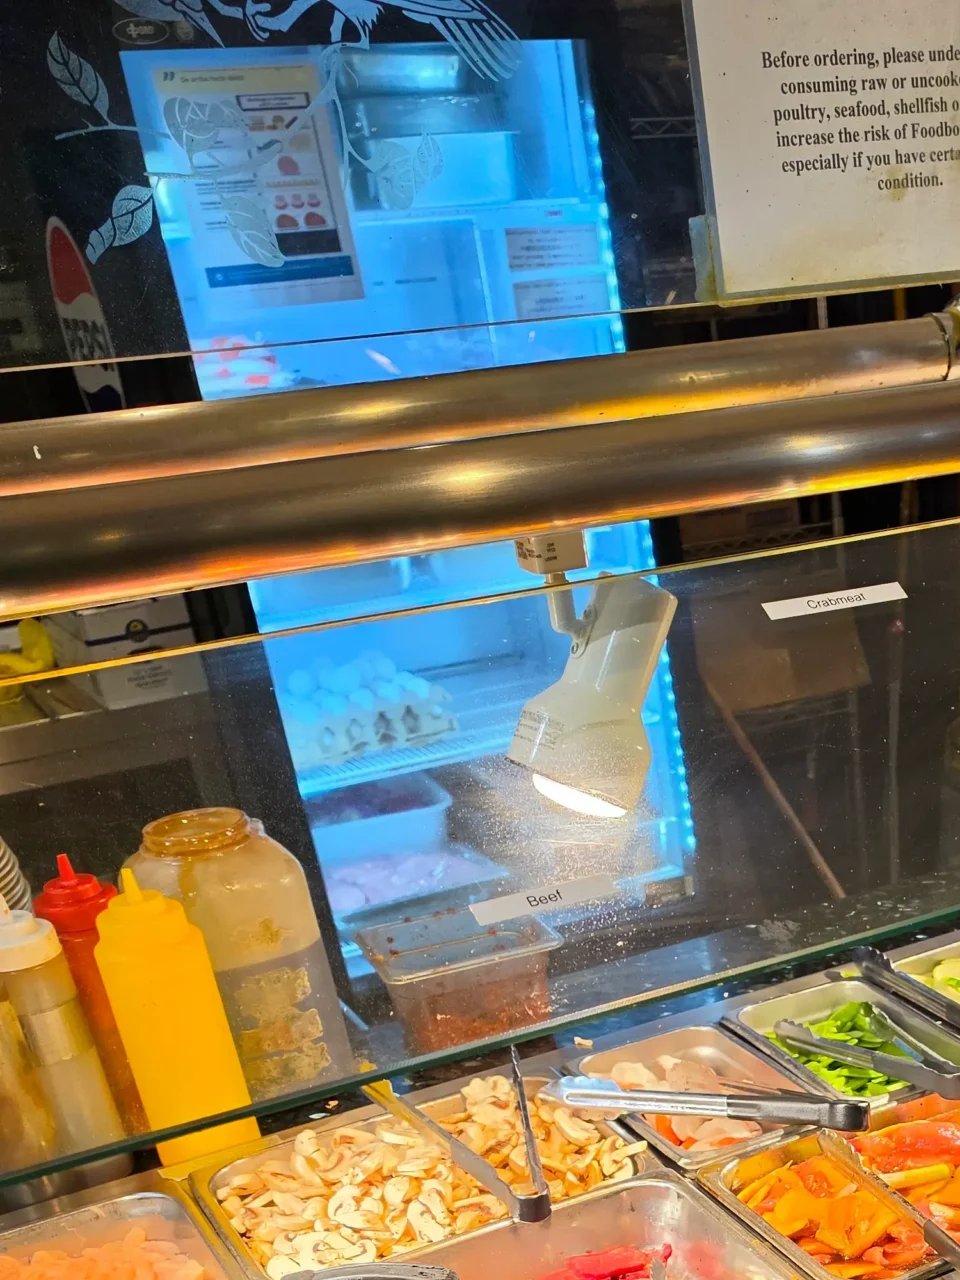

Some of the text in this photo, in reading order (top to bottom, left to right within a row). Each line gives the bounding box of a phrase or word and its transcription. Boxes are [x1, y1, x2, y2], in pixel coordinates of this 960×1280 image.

[761, 51, 810, 69] Before
[814, 48, 880, 70] ordering,
[883, 47, 925, 69] please
[780, 75, 858, 96] consuming
[861, 77, 887, 91] raw
[892, 76, 907, 90] or
[773, 103, 832, 126] poultry,
[834, 100, 891, 119] seafood,
[894, 96, 948, 115] shellfish
[776, 131, 835, 147] increase
[838, 127, 860, 144] the
[864, 125, 891, 142] risk
[894, 123, 908, 140] of
[781, 153, 849, 176] especially
[852, 151, 864, 168] if
[866, 152, 891, 171] you
[895, 149, 926, 165] have
[877, 171, 943, 190] condition.
[806, 592, 867, 610] Crabmeat
[526, 889, 563, 908] Beef
